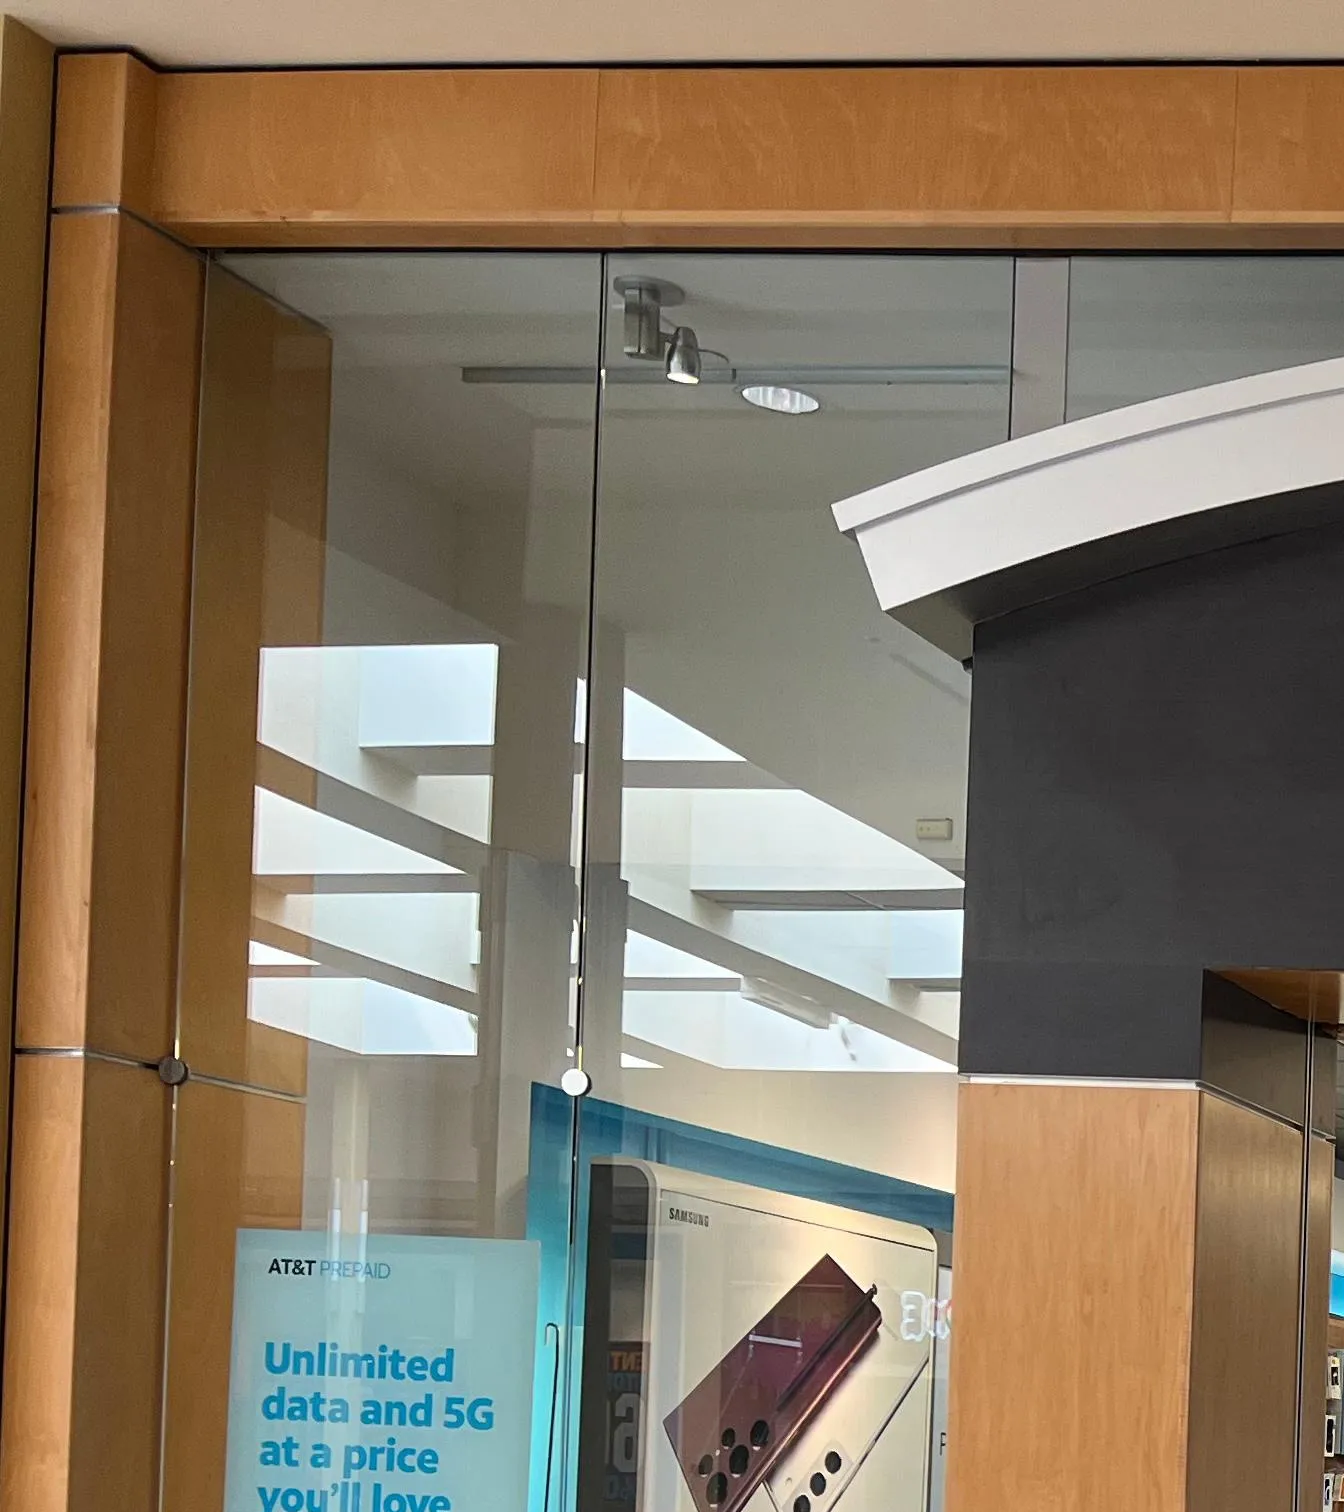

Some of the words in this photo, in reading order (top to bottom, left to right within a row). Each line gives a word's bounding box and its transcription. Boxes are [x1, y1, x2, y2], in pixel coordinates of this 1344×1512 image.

[669, 1208, 709, 1227] SAMSUNG
[268, 1258, 316, 1276] AT&T
[320, 1260, 391, 1279] PREPAID
[265, 1342, 454, 1382] Unlimited
[262, 1386, 349, 1423] data
[360, 1393, 433, 1427] and
[443, 1397, 494, 1430] 5G
[259, 1436, 299, 1467] at
[310, 1443, 331, 1468] a
[343, 1437, 439, 1479] price
